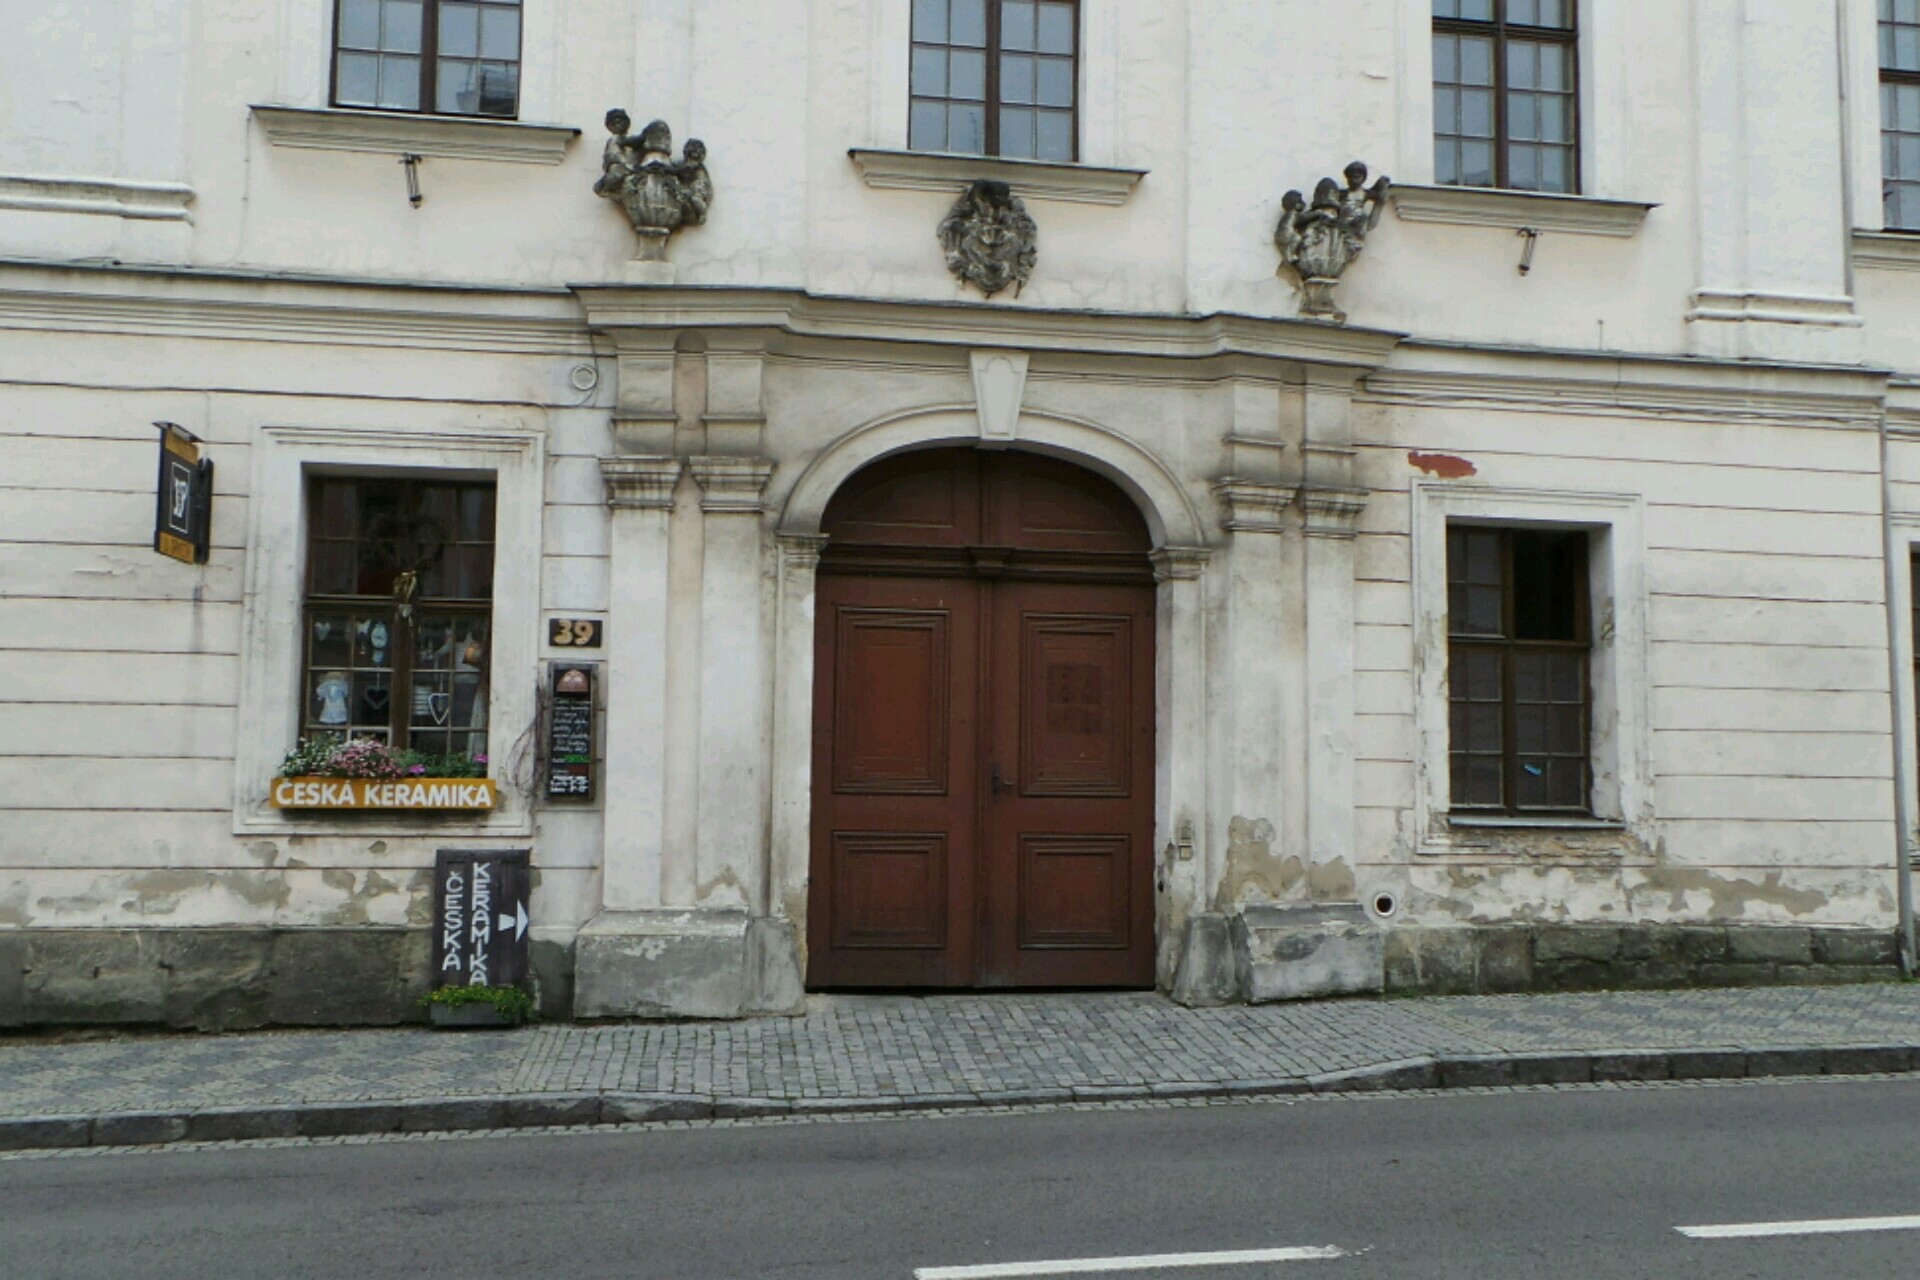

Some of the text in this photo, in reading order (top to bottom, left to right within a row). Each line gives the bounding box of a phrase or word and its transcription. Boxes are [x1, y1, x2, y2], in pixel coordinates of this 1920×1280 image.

[553, 619, 593, 645] 39
[276, 778, 492, 807] ČESKÁ KERAMIKA
[442, 870, 464, 971] ČESKÁ
[469, 862, 491, 987] KERAMIKA
